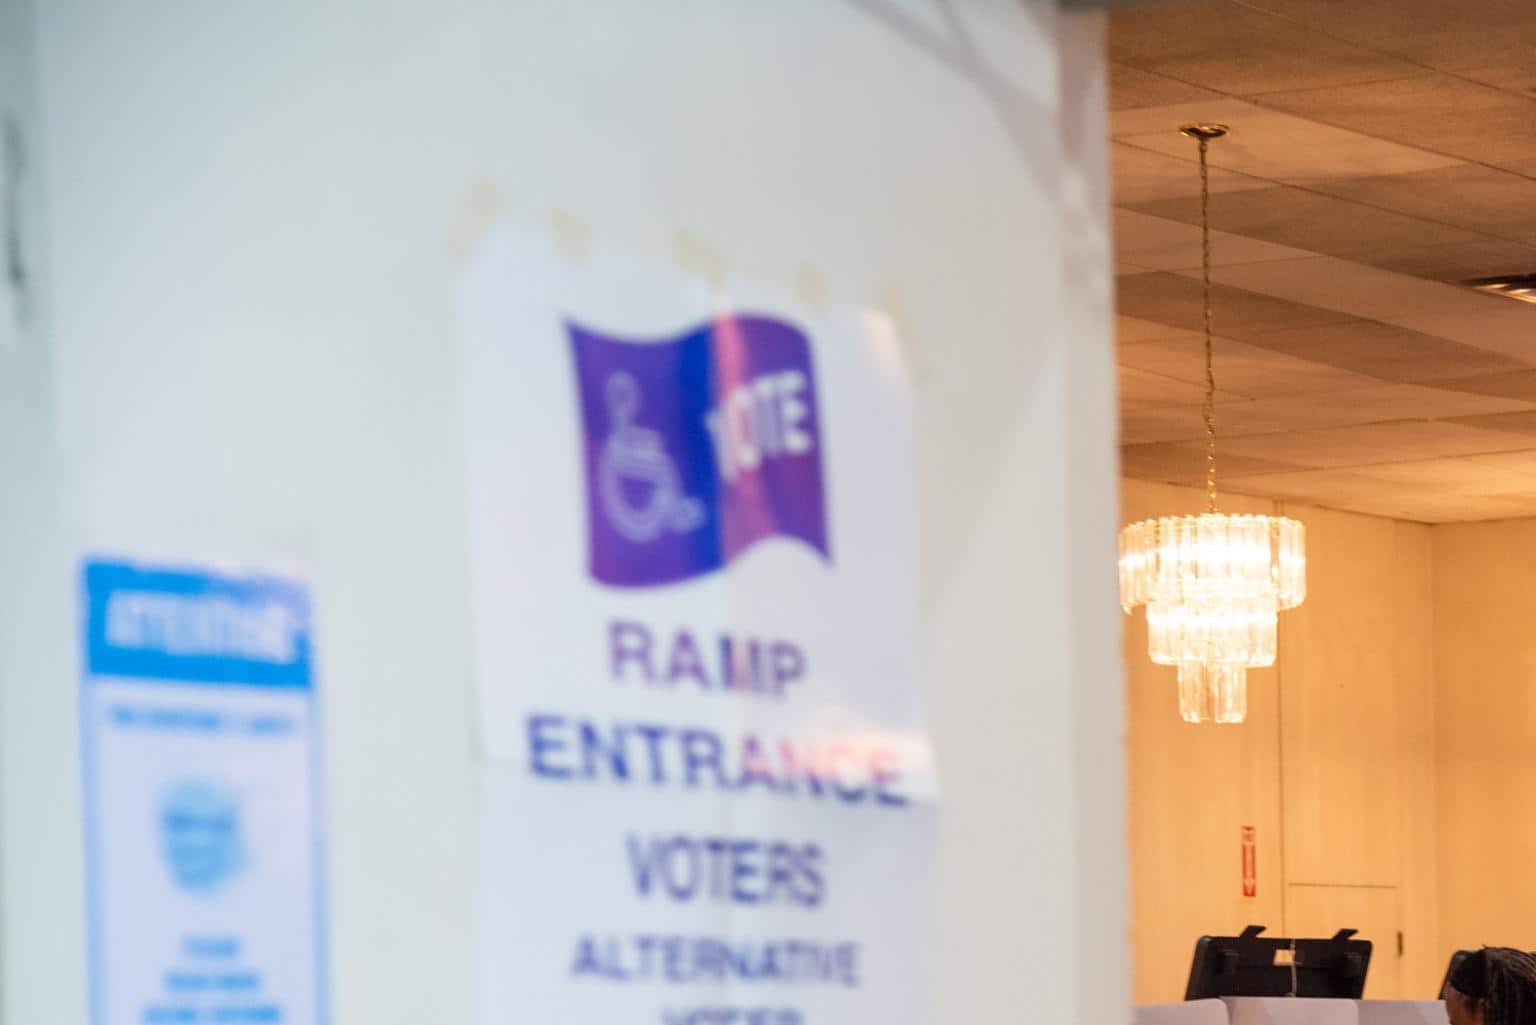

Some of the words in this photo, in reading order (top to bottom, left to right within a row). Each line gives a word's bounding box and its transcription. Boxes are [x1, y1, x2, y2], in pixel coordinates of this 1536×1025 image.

[607, 620, 806, 696] RAMP
[526, 713, 909, 807] ENTRANCE
[625, 833, 827, 908] VOTERS
[572, 934, 862, 987] ALTERNATIVE
